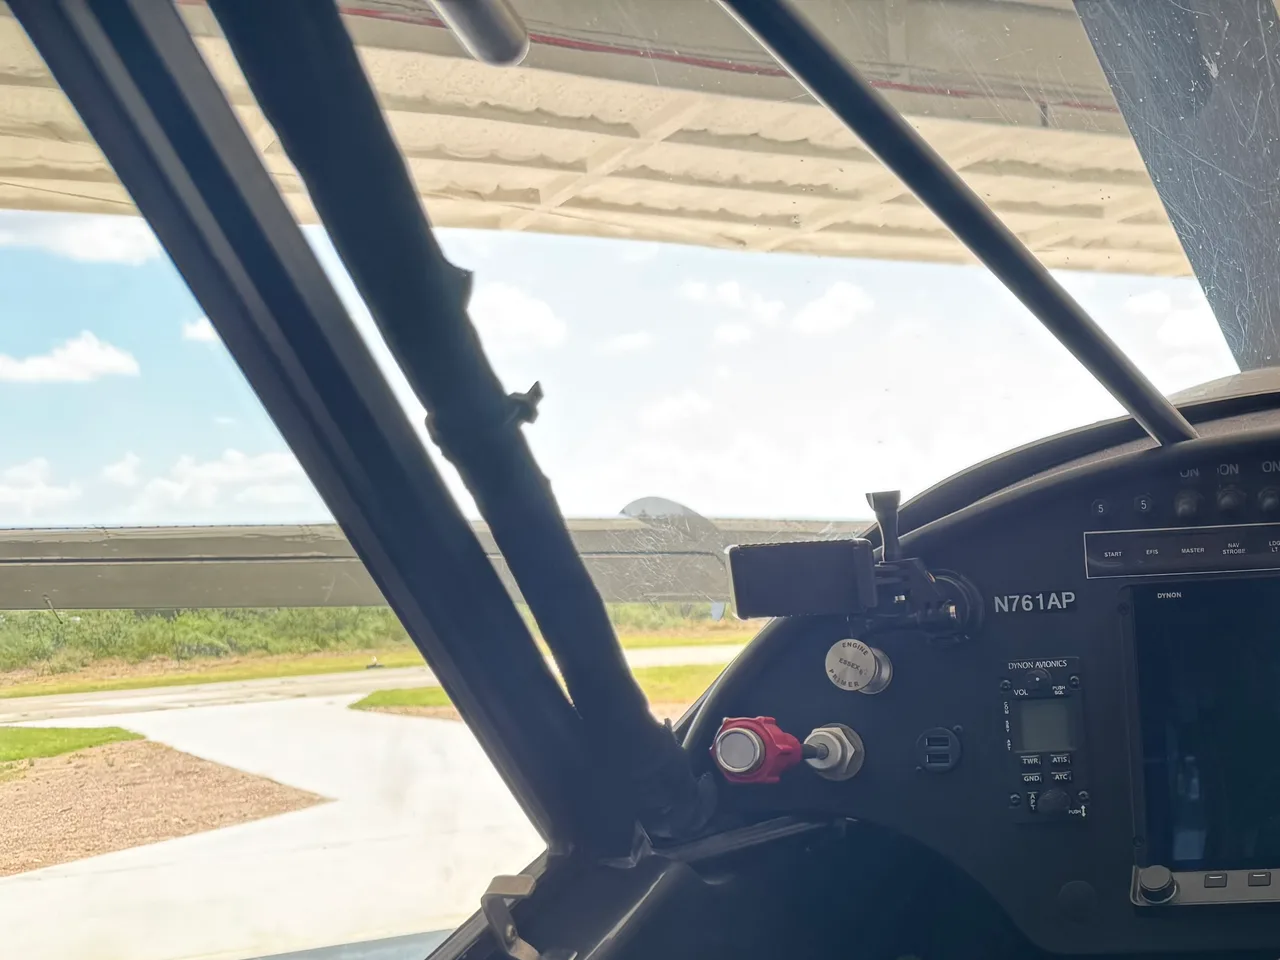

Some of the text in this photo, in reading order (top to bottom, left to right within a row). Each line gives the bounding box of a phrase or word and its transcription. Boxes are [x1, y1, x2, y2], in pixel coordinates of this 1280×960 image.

[1220, 464, 1238, 475] ON
[1262, 461, 1280, 472] ON
[1141, 501, 1147, 509] 5
[994, 592, 1076, 612] N761AP
[842, 642, 868, 656] ENGINE
[839, 658, 860, 670] ESSEX
[1008, 660, 1067, 669] DYNON AVIONICS
[829, 669, 859, 687] PRIMER
